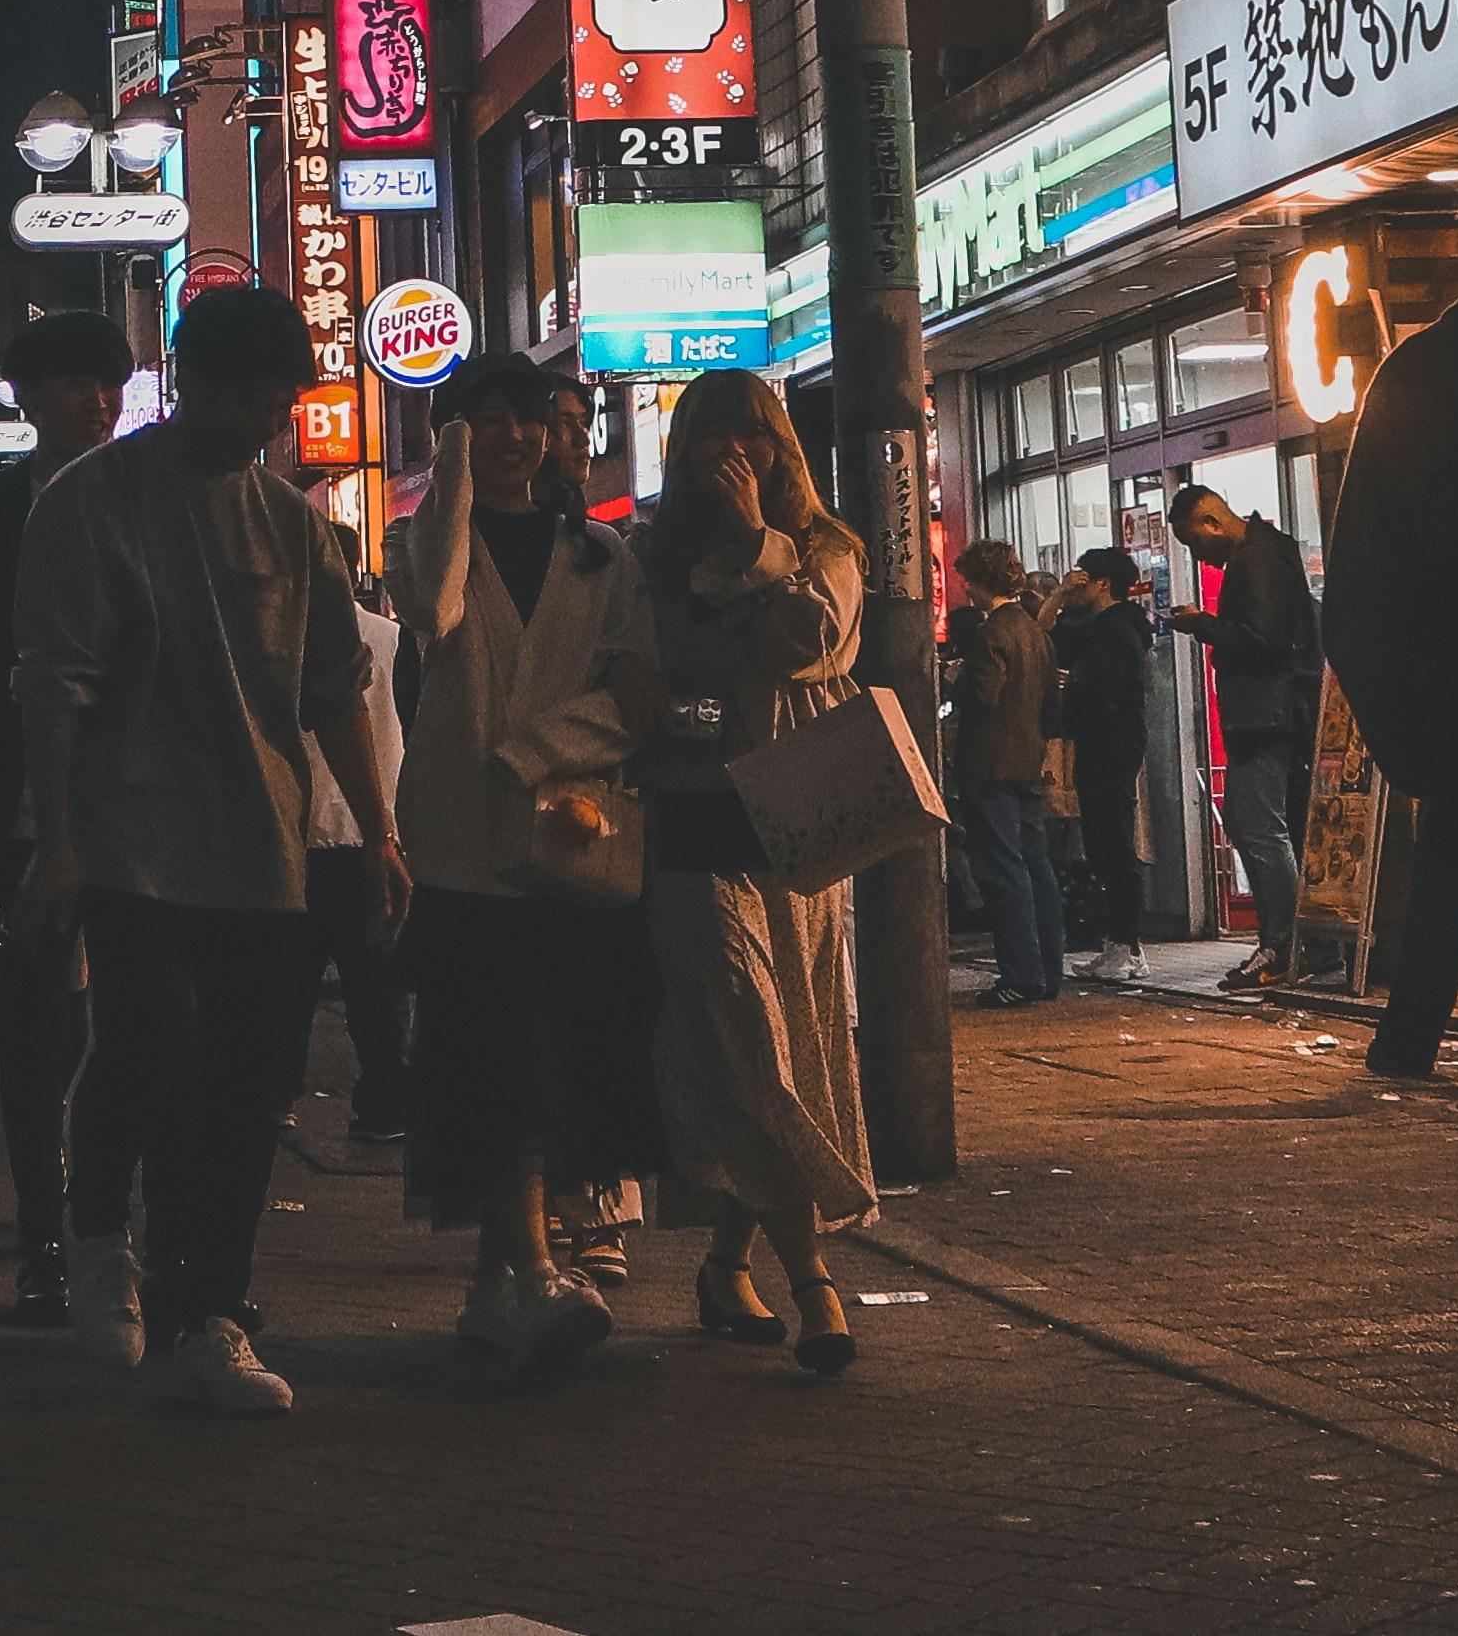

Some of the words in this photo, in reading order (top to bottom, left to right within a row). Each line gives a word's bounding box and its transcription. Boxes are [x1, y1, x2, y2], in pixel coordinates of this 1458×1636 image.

[1184, 44, 1229, 144] 5F
[341, 170, 434, 198] センタービル
[24, 206, 183, 233] 渋谷センター街
[301, 228, 350, 331] かわ串
[377, 301, 457, 338] BURGER
[380, 321, 459, 362] KING
[643, 332, 673, 364] 酒
[680, 334, 738, 361] たばこ
[306, 401, 352, 440] B1
